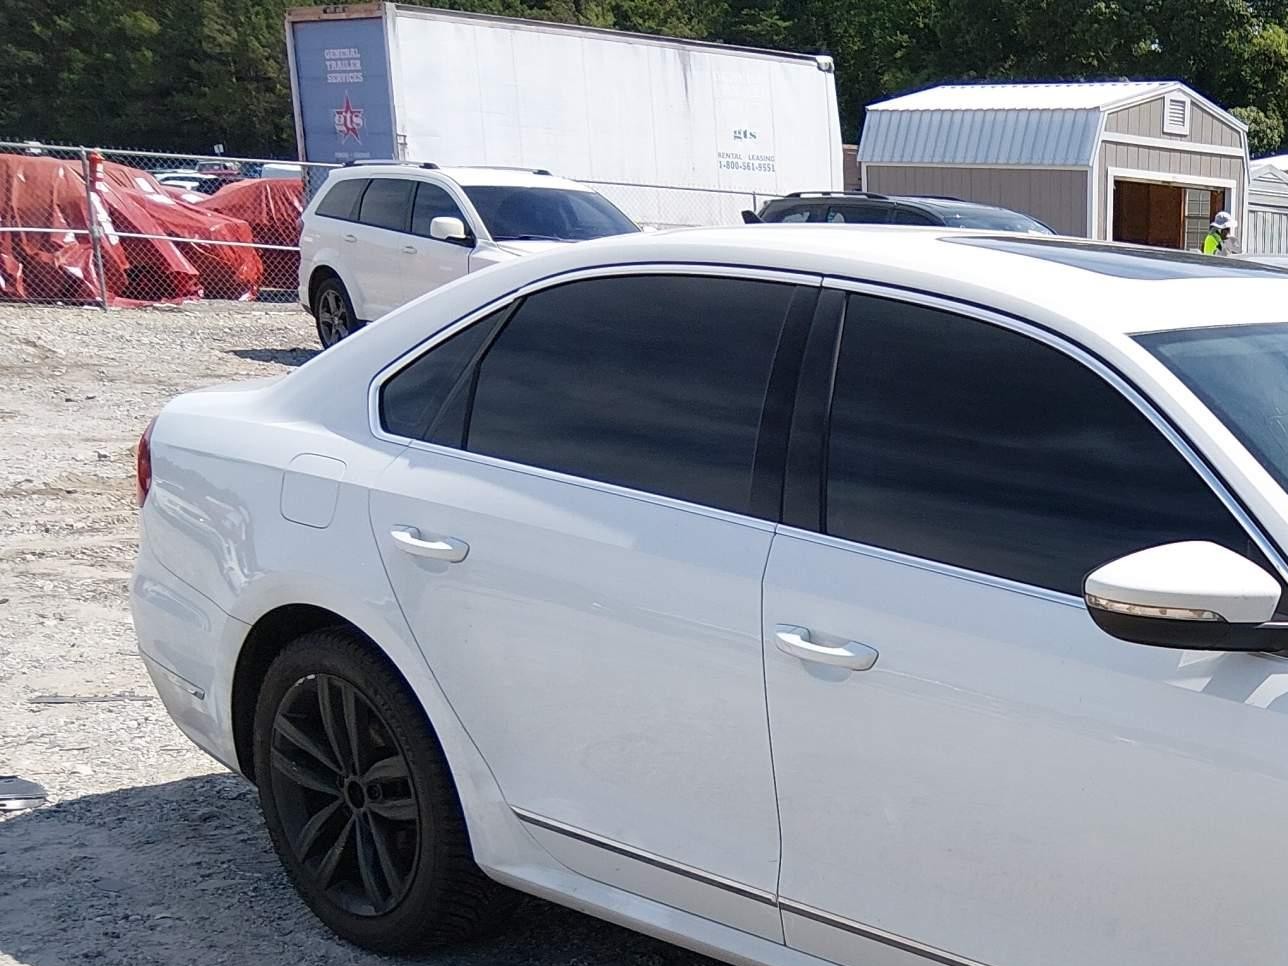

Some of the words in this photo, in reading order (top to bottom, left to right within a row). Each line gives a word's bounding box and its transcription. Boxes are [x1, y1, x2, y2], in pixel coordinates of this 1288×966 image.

[324, 48, 361, 59] GENERAL
[325, 60, 362, 70] TRAILER
[327, 72, 364, 83] SERVICES
[335, 111, 363, 134] gts
[717, 152, 743, 160] RENTAL
[748, 154, 775, 162] LEASING
